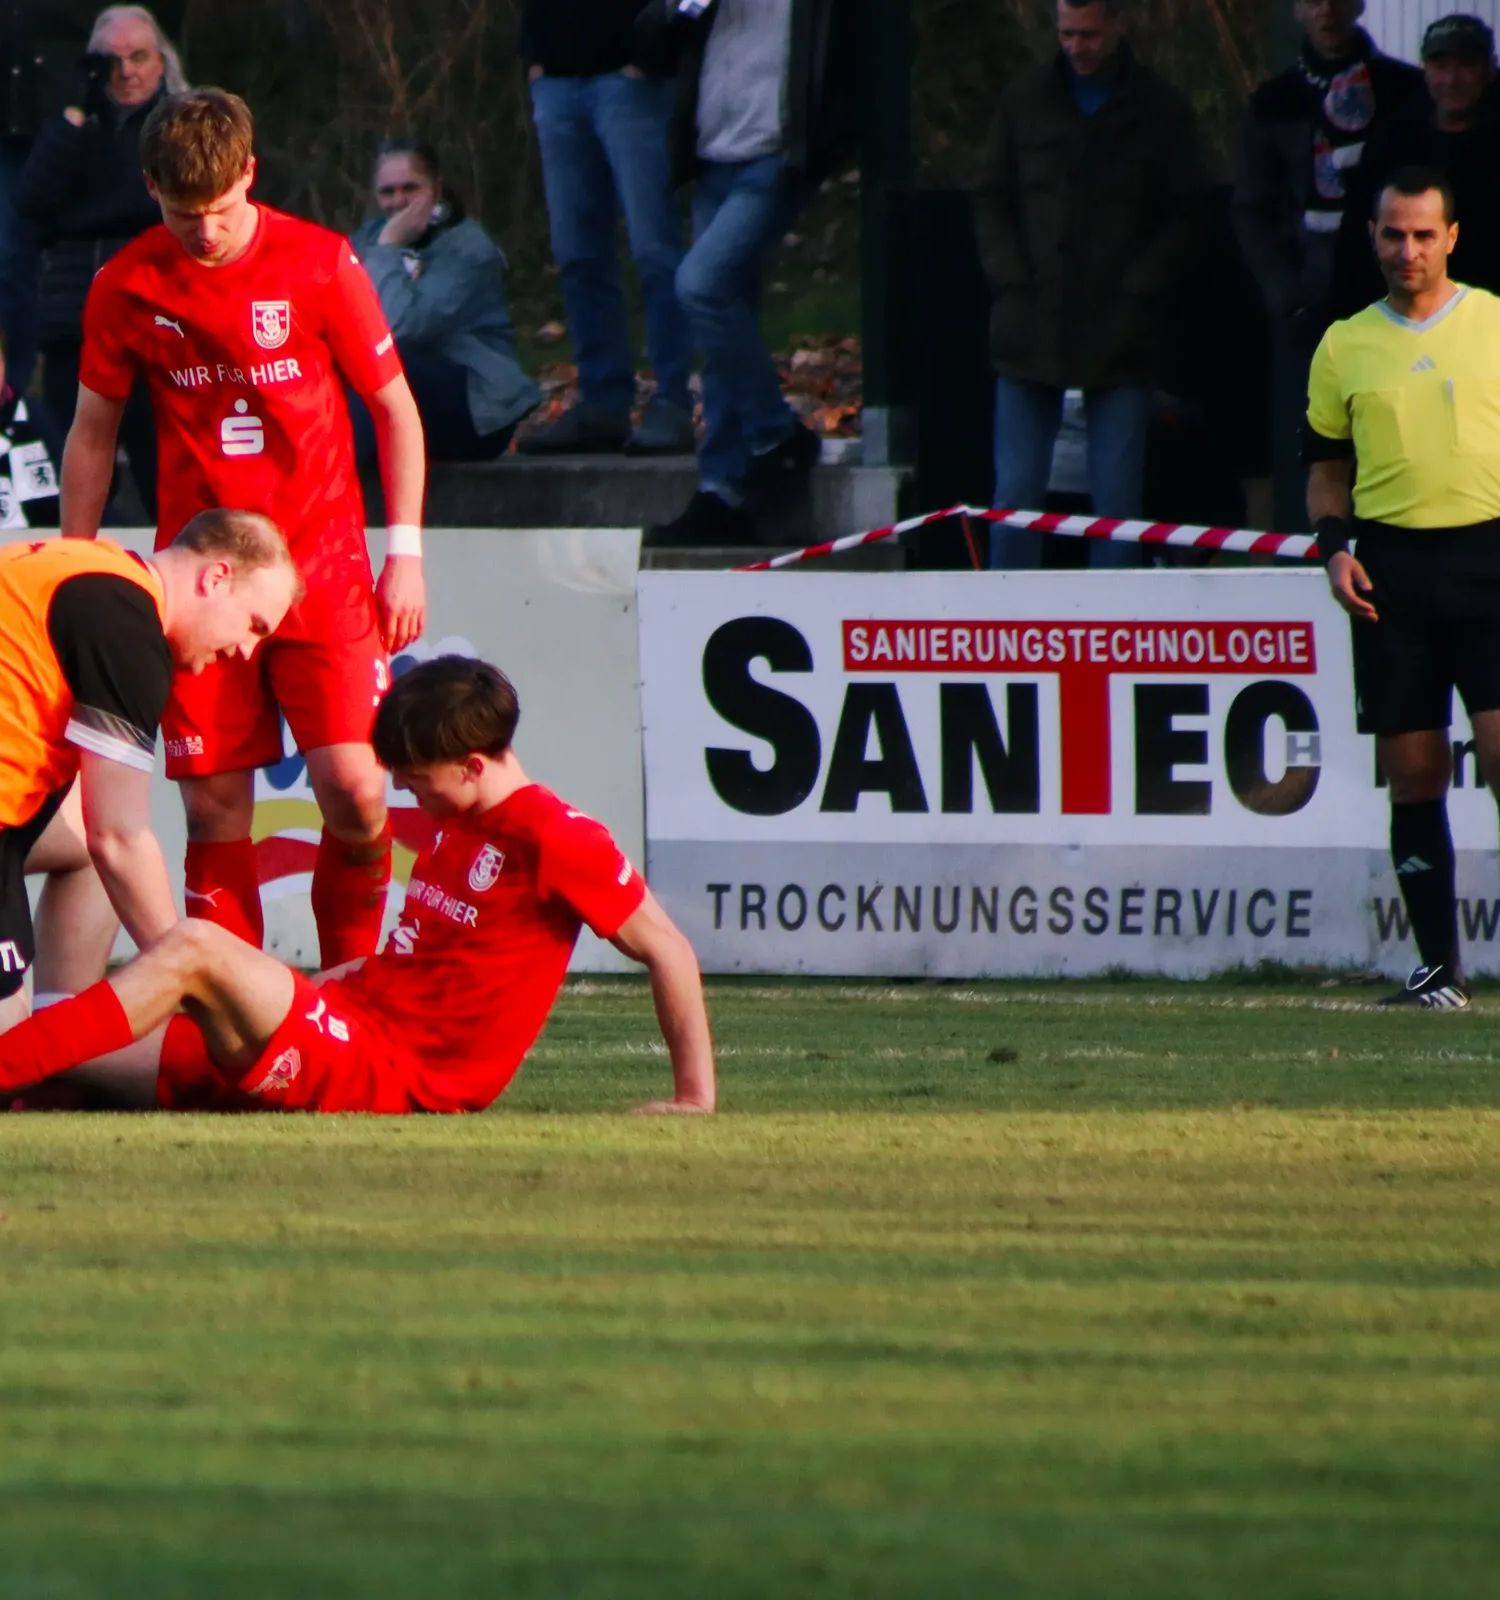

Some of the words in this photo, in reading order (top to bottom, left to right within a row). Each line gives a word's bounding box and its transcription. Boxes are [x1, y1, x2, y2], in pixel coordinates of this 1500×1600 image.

[169, 366, 212, 387] WIR
[216, 363, 247, 385] FÜR
[251, 358, 302, 386] HIER
[850, 627, 1309, 664] SANIERUNGSTECHNOLOGIE
[440, 895, 479, 929] HIER
[706, 882, 1314, 938] TROCKNUNGSSERVICE
